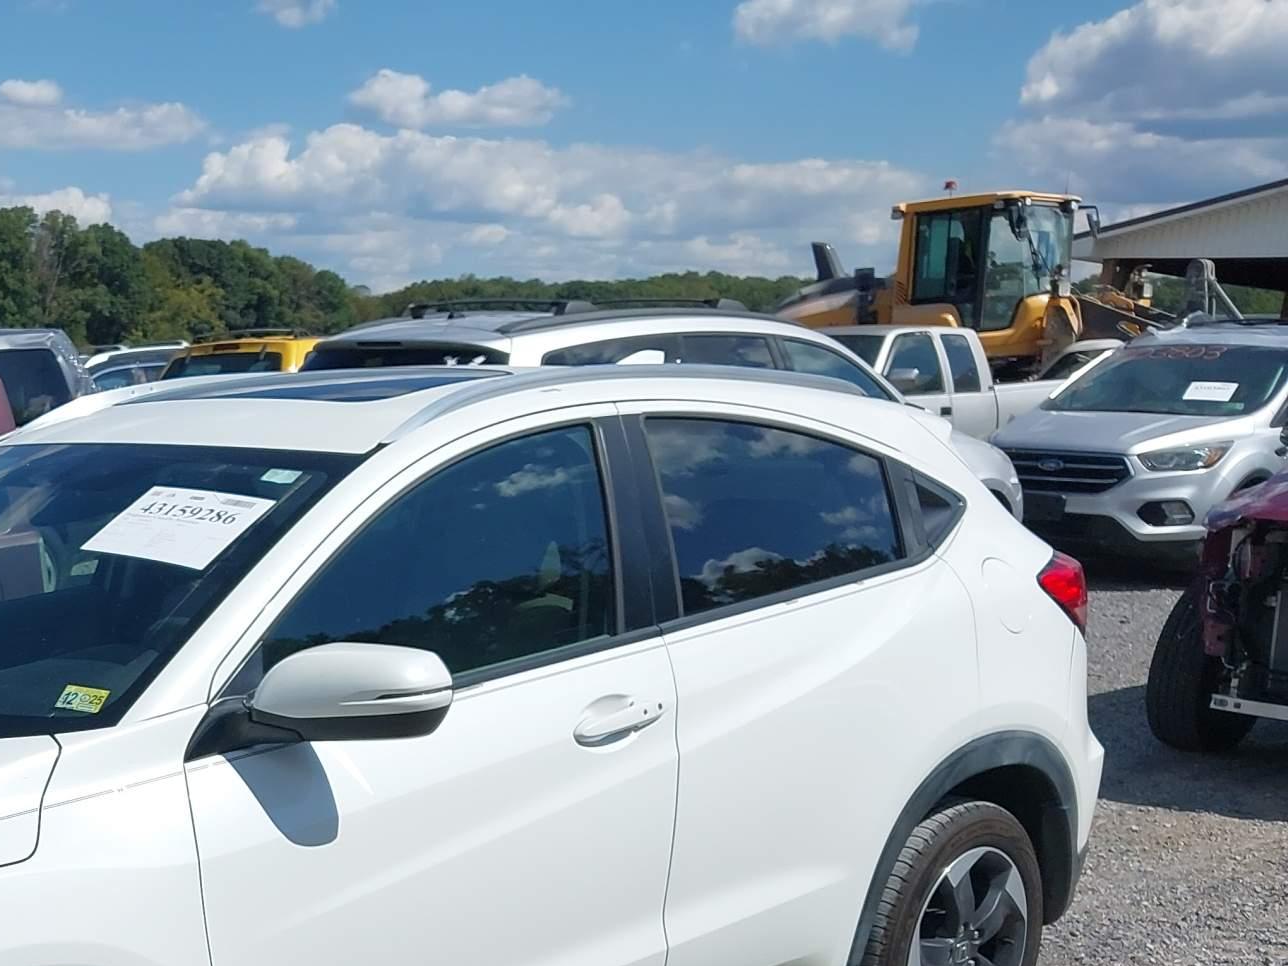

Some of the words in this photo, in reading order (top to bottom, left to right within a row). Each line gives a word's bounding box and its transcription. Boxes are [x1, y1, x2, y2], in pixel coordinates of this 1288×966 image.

[140, 501, 240, 525] 43159286
[62, 691, 79, 705] 12
[88, 694, 105, 705] 25
